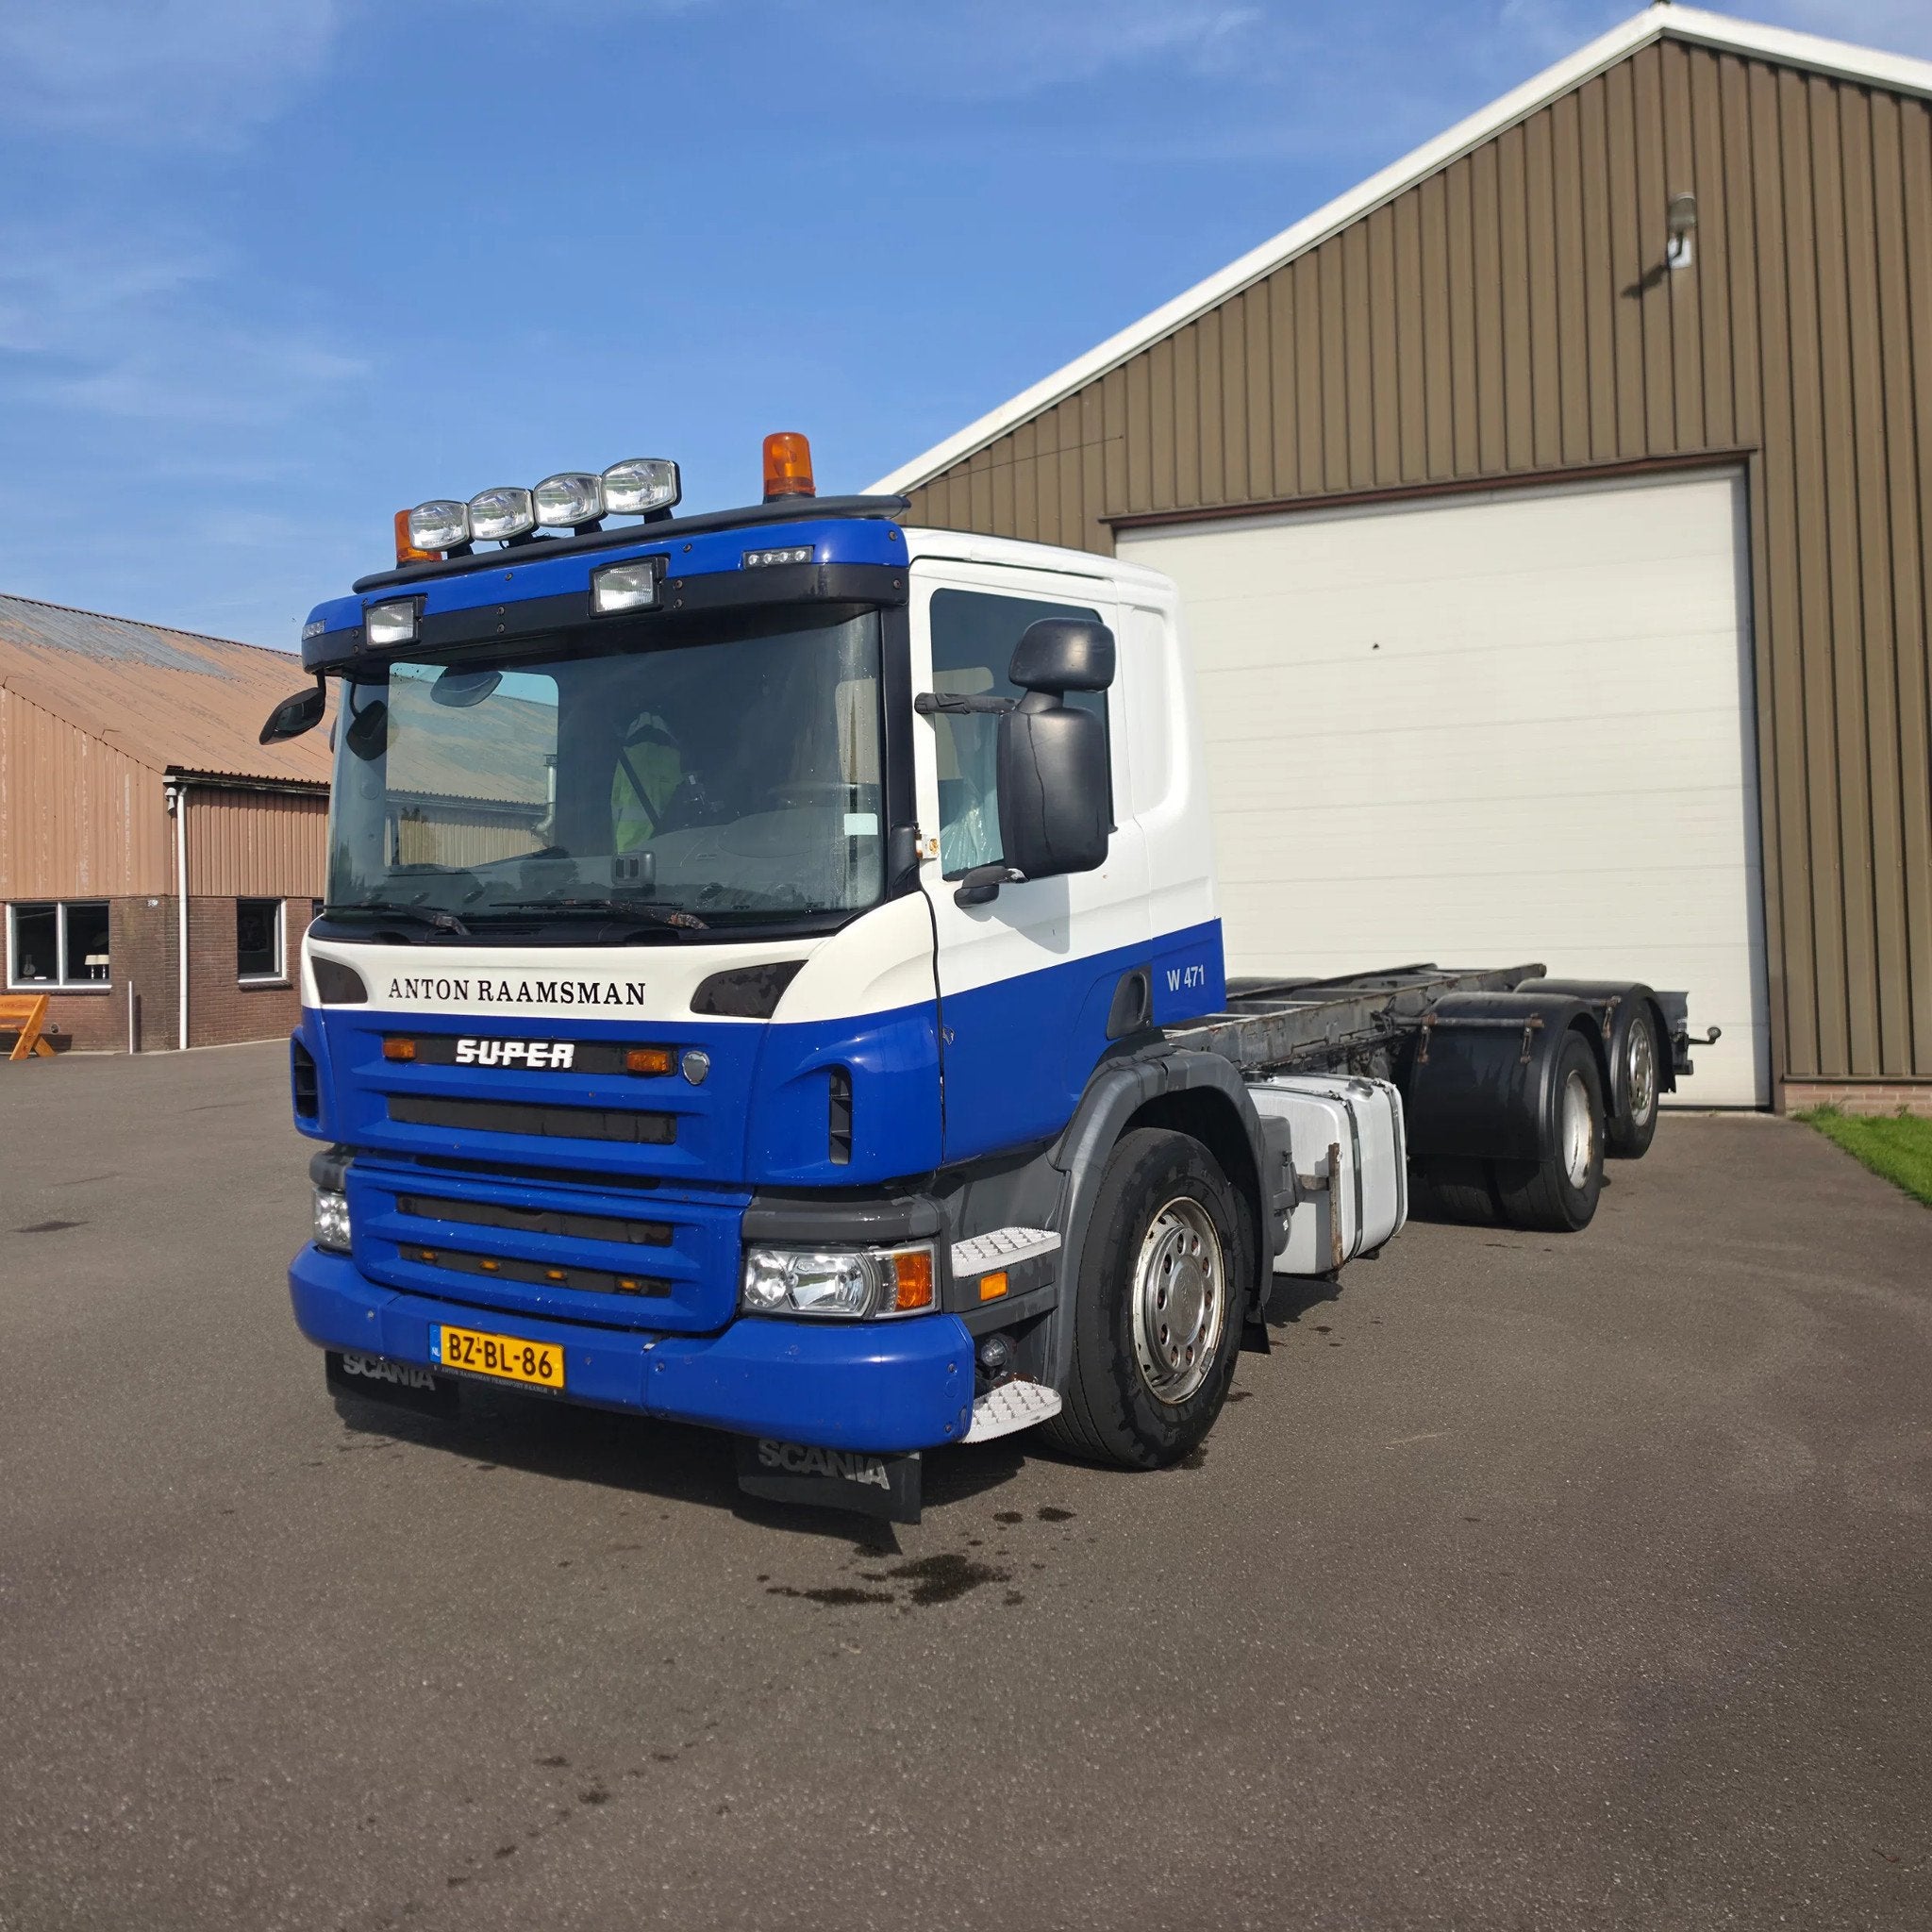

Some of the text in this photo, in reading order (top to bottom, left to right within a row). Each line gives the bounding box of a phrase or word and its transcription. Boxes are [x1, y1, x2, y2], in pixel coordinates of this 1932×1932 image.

[388, 977, 646, 1006] ANTON RAAMSMAN
[1166, 964, 1205, 992] W 471
[456, 1039, 575, 1069] SUPER
[342, 1353, 436, 1391] SCANIA
[448, 1333, 554, 1379] BZ-BL-86
[758, 1438, 891, 1491] SCANIA
